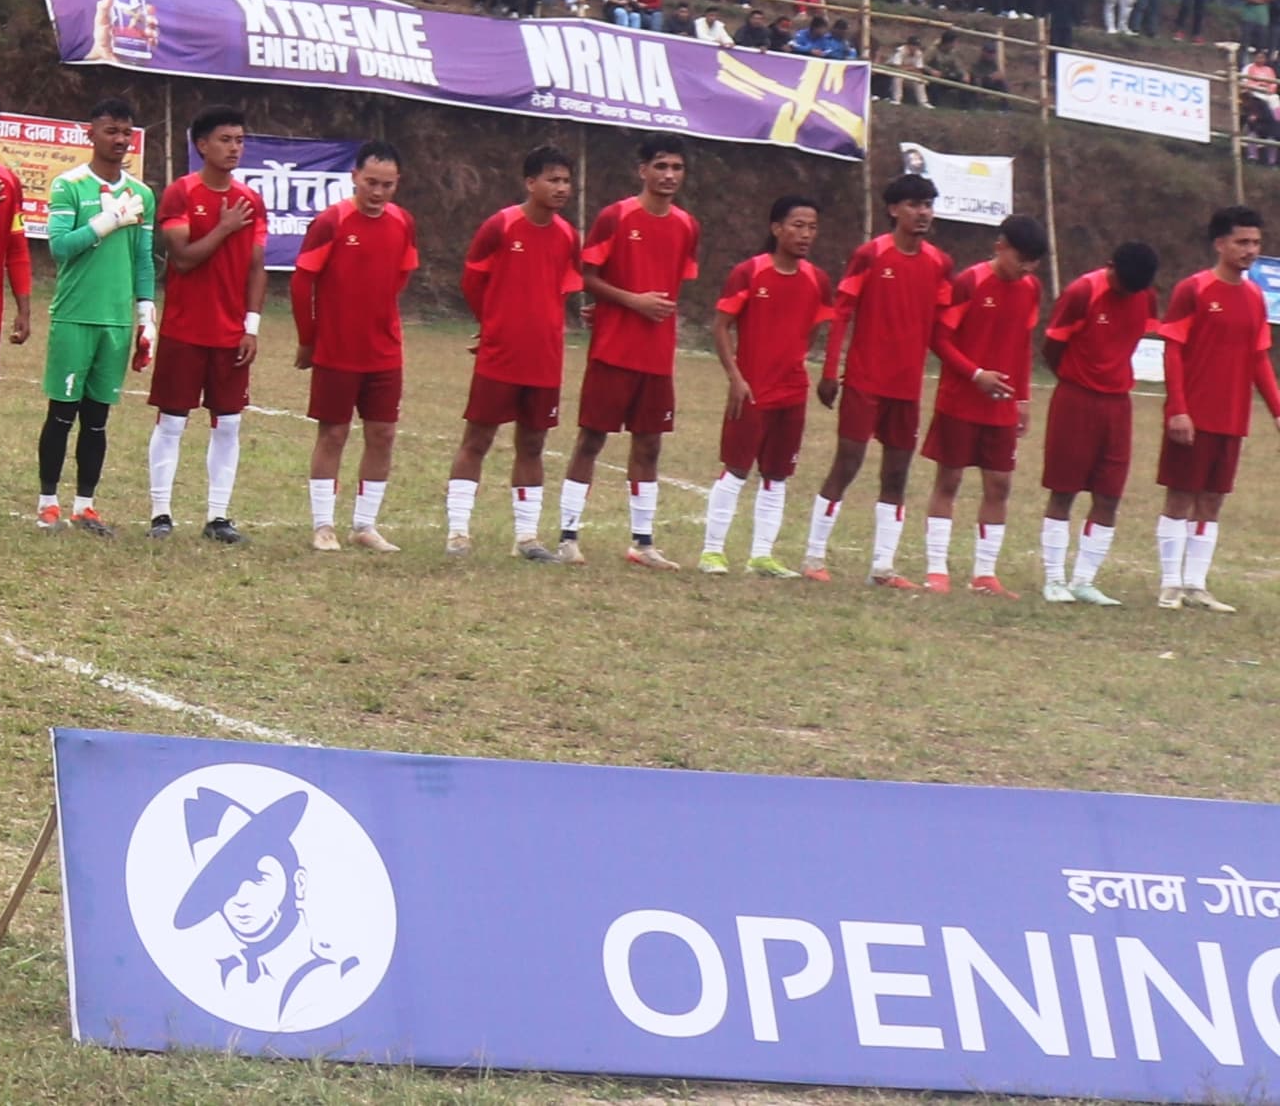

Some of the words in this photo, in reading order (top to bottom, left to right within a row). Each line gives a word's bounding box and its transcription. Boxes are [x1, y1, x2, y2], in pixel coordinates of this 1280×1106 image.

[247, 35, 350, 73] ENERGY
[356, 48, 440, 87] DRINK
[519, 24, 683, 111] NRNA
[1110, 70, 1203, 104] FRIENDS
[1061, 868, 1186, 914] इलाम
